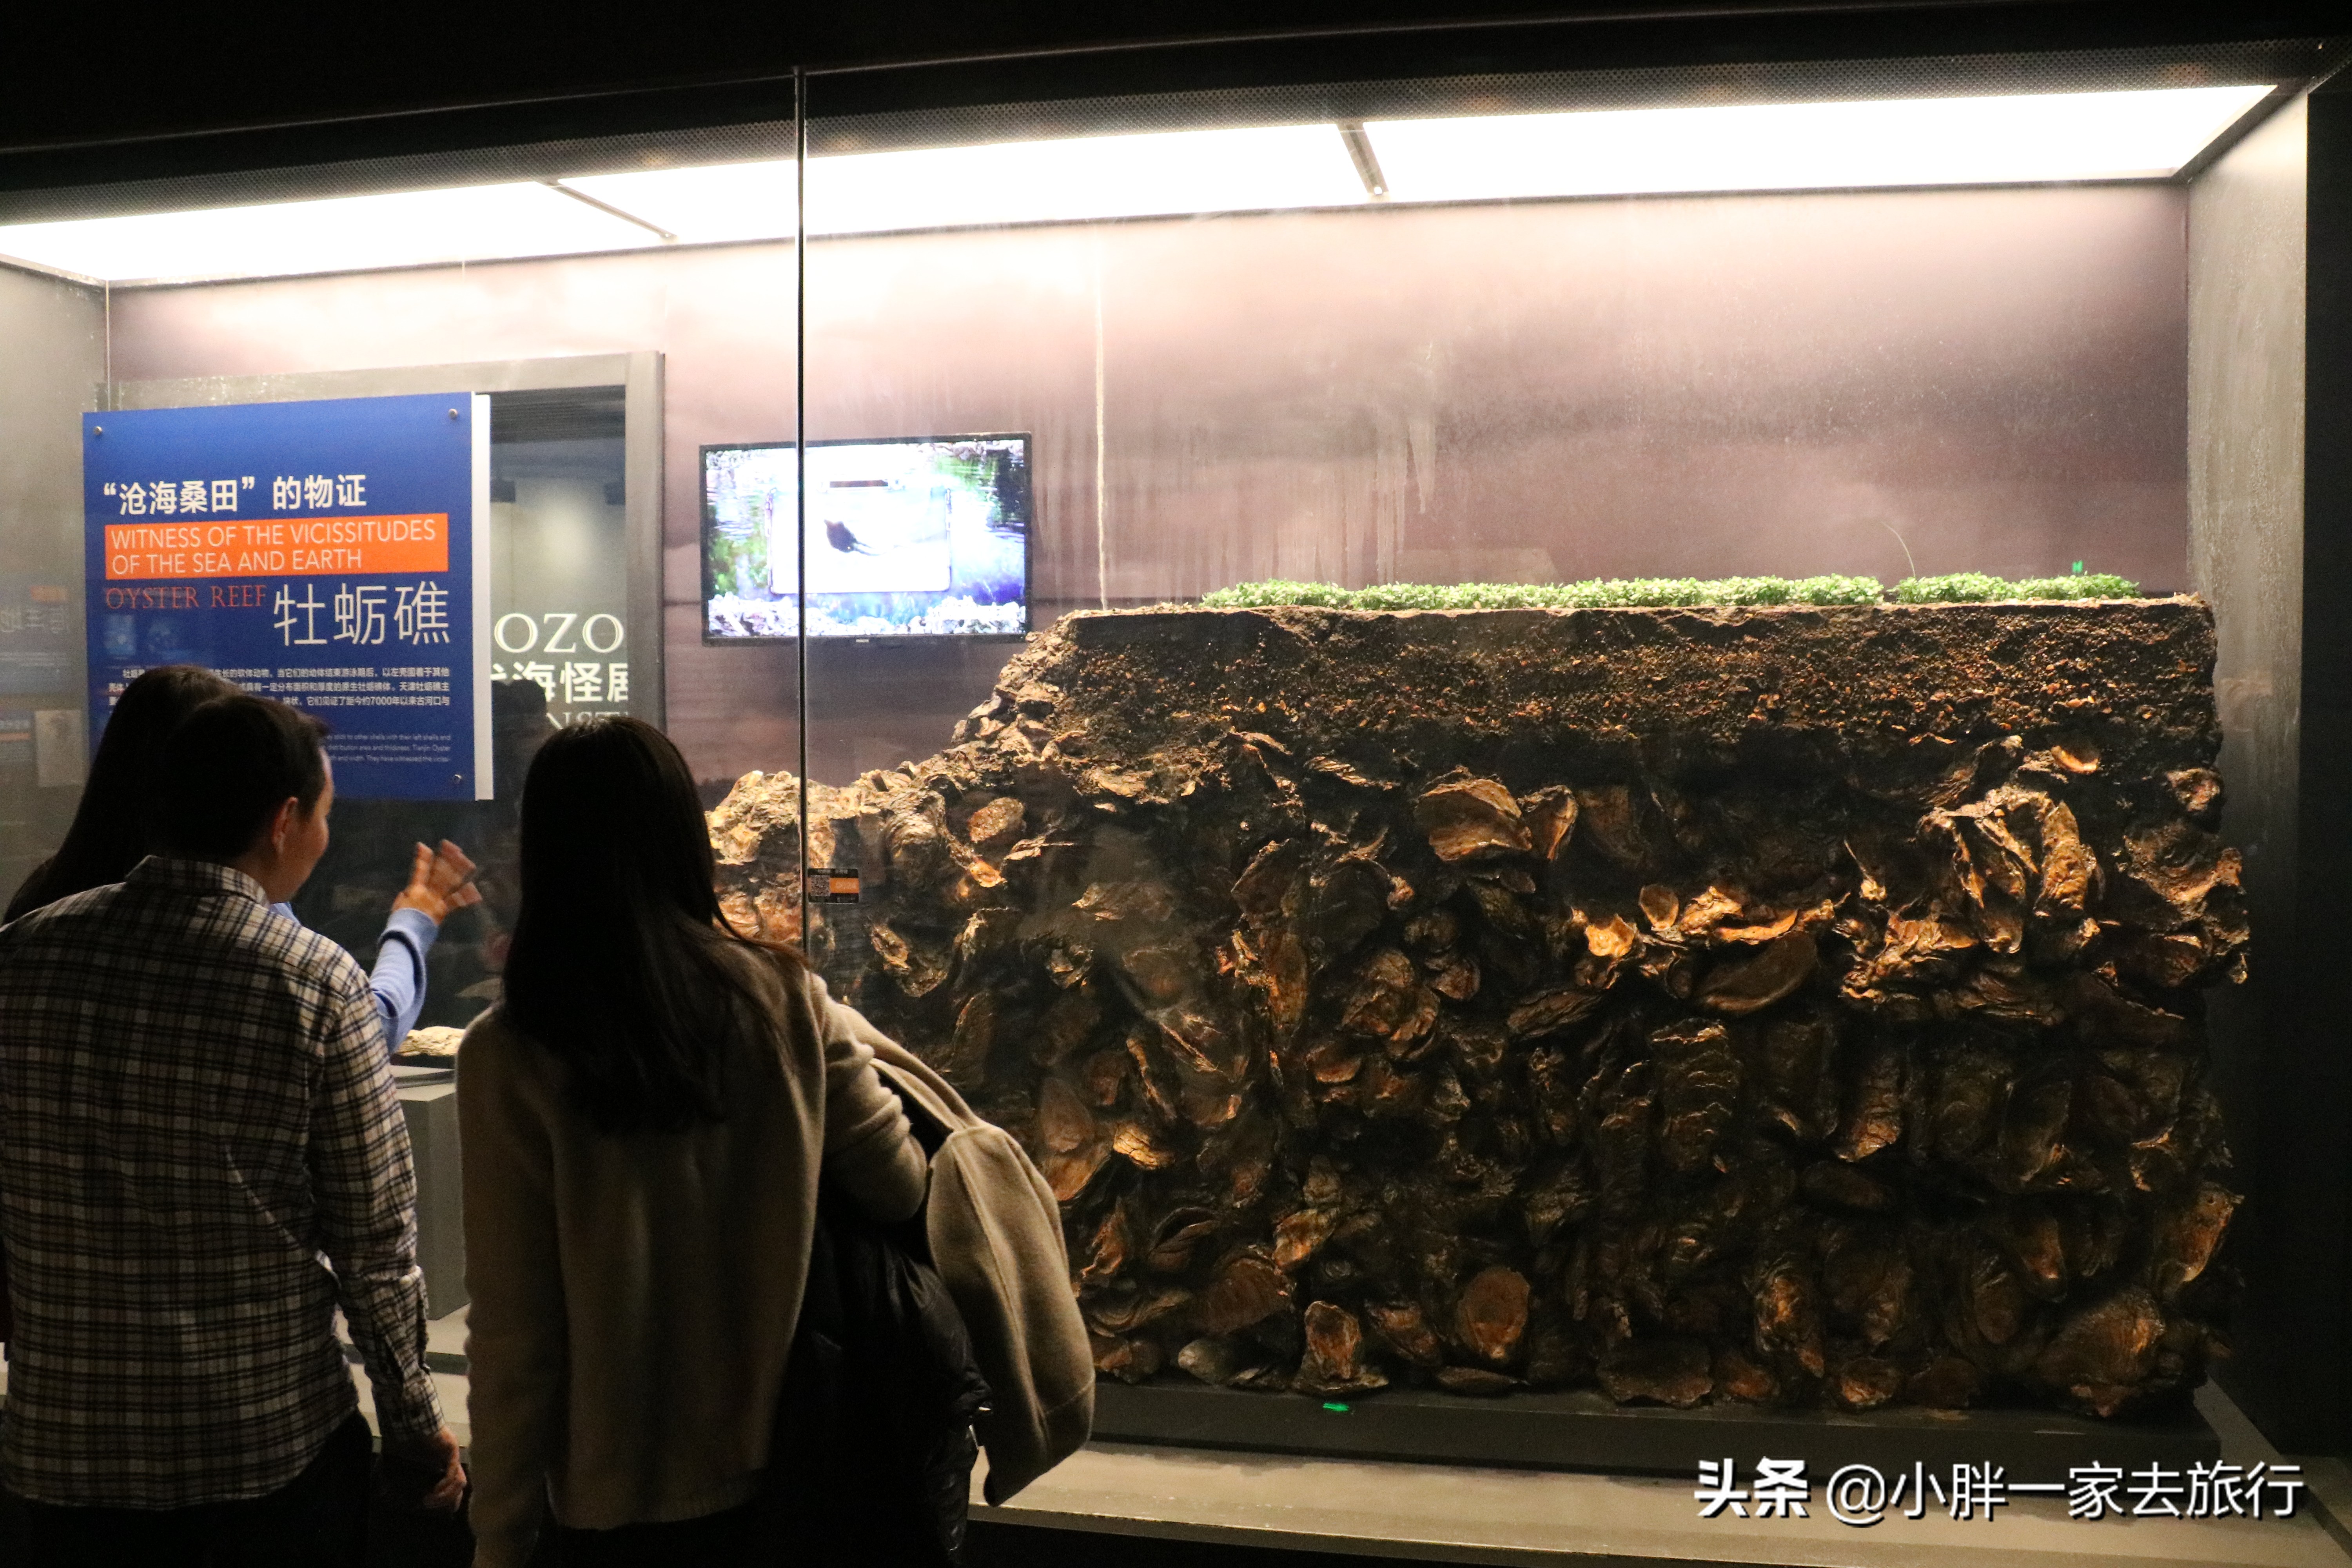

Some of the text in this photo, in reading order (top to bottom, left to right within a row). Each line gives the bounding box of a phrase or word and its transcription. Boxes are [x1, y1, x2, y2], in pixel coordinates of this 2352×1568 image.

[111, 519, 436, 549] WITNESS OF THE VICISSITUDES
[112, 550, 362, 575] OF THE SEA AND EARTH
[106, 585, 267, 609] OYSTER REEF
[273, 581, 450, 646] 牡蛎礁
